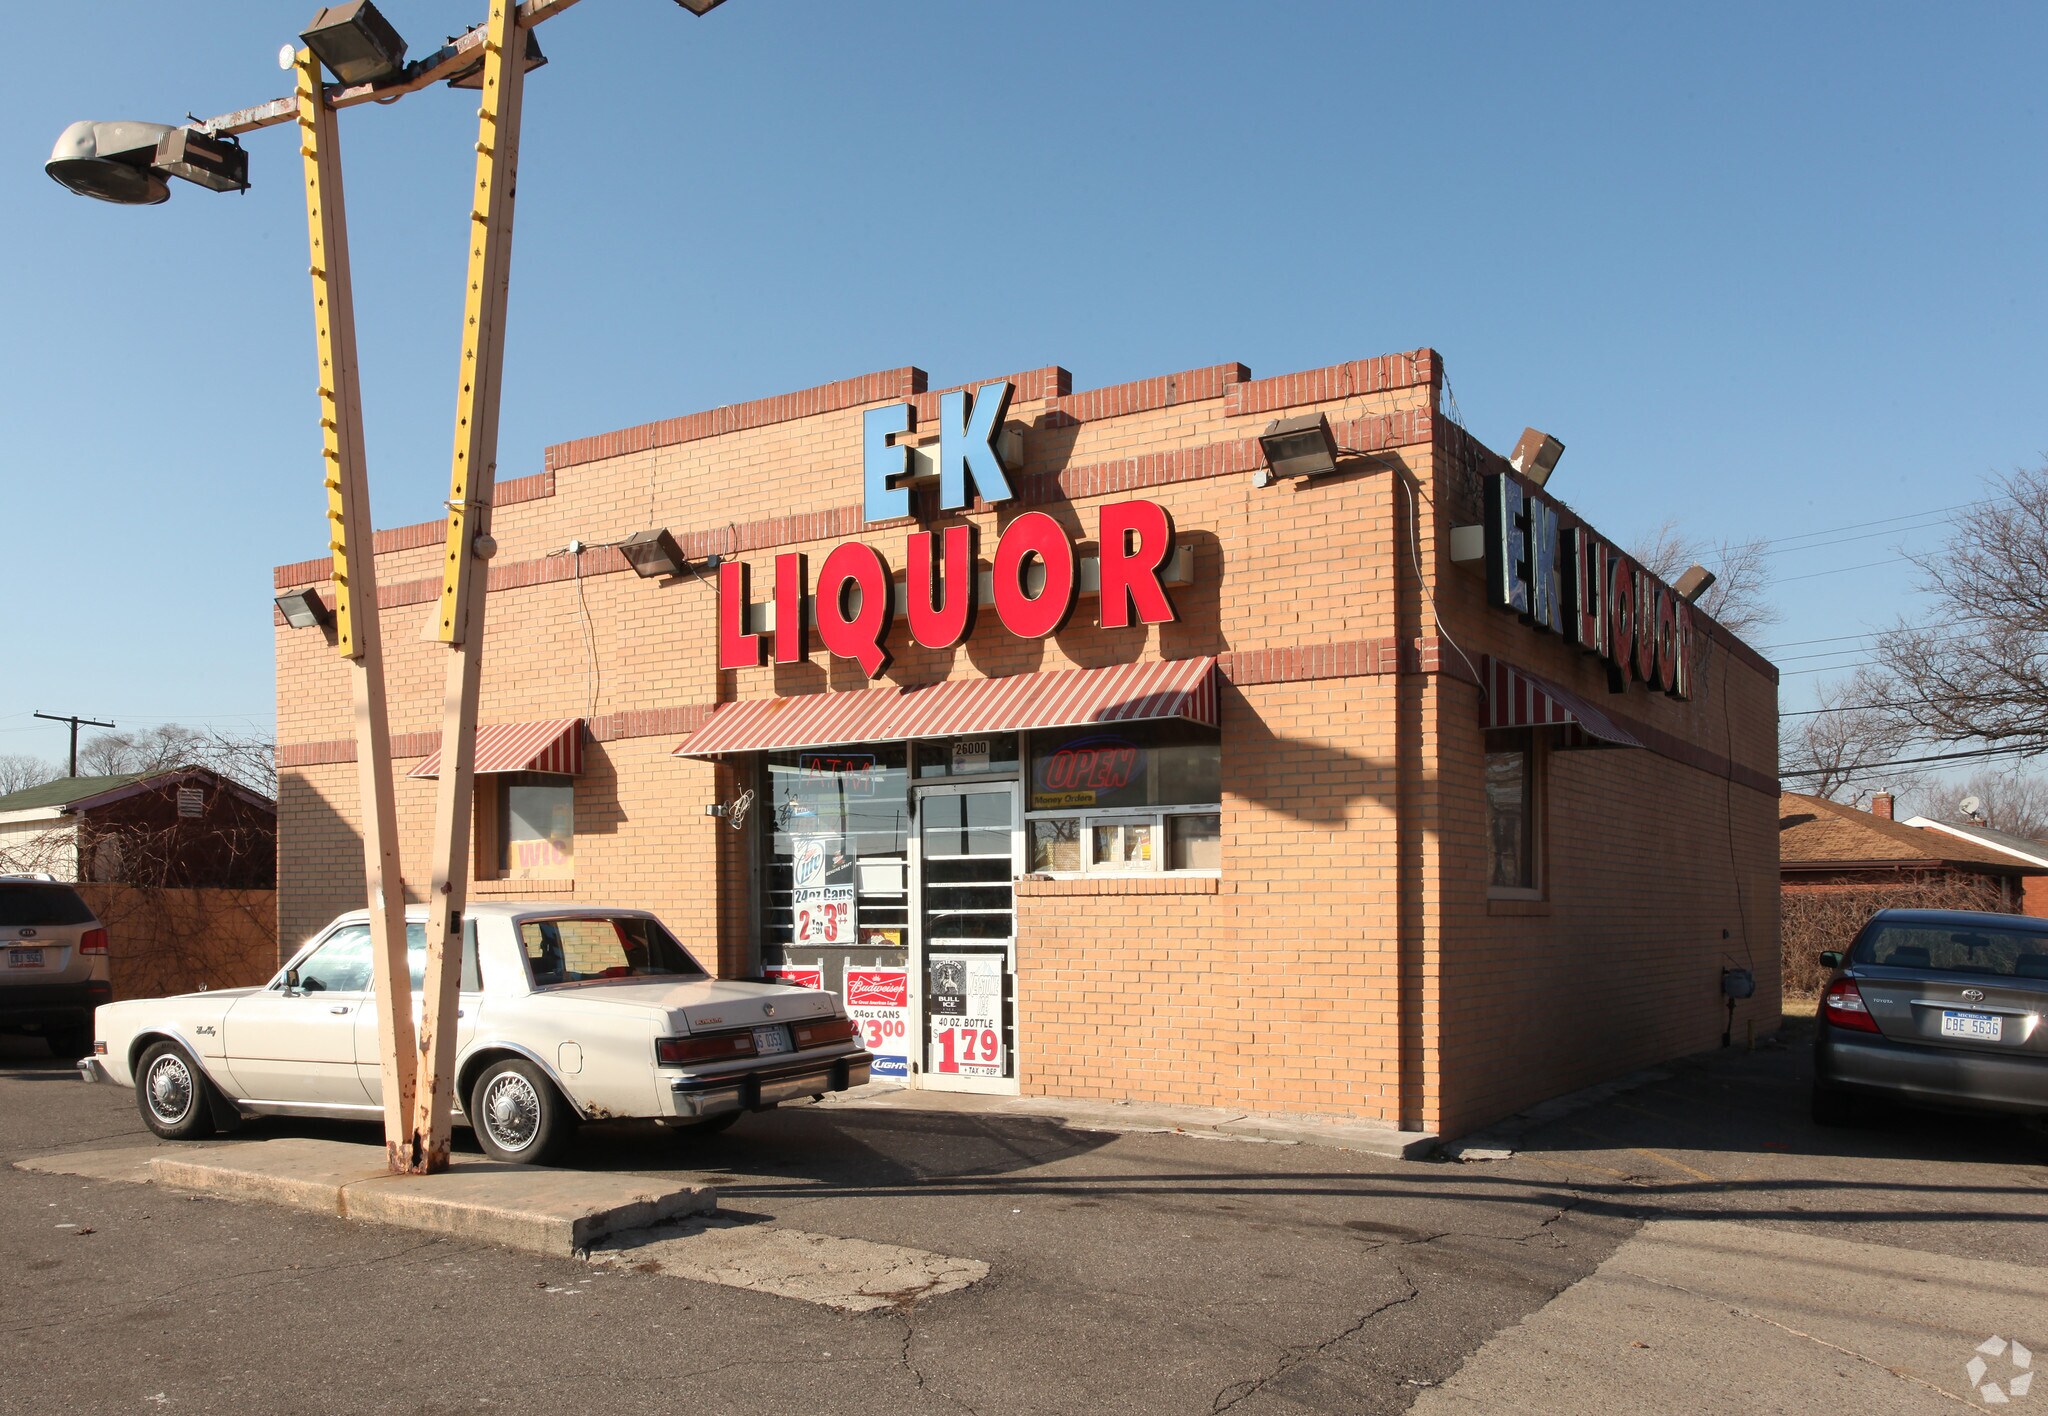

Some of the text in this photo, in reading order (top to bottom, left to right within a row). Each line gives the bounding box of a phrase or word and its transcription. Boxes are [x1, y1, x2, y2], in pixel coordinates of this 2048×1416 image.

[863, 380, 1013, 523] EK
[1499, 472, 1563, 635] EK
[719, 499, 1174, 680] LIQUOR
[1572, 527, 1693, 701] LIQUOR
[956, 742, 986, 754] 26000
[807, 758, 871, 792] ATM
[1047, 748, 1136, 789] OPEN
[1034, 793, 1093, 806] Money Orders
[518, 841, 568, 868] WIC
[849, 981, 905, 993] Budweiser
[854, 1010, 874, 1018] 24oz
[939, 1018, 993, 1028] 40 OZ. BOTTLE
[1945, 1018, 1999, 1035] CBE 5636
[766, 1033, 782, 1047] 0353
[876, 1060, 904, 1069] LIGHT
